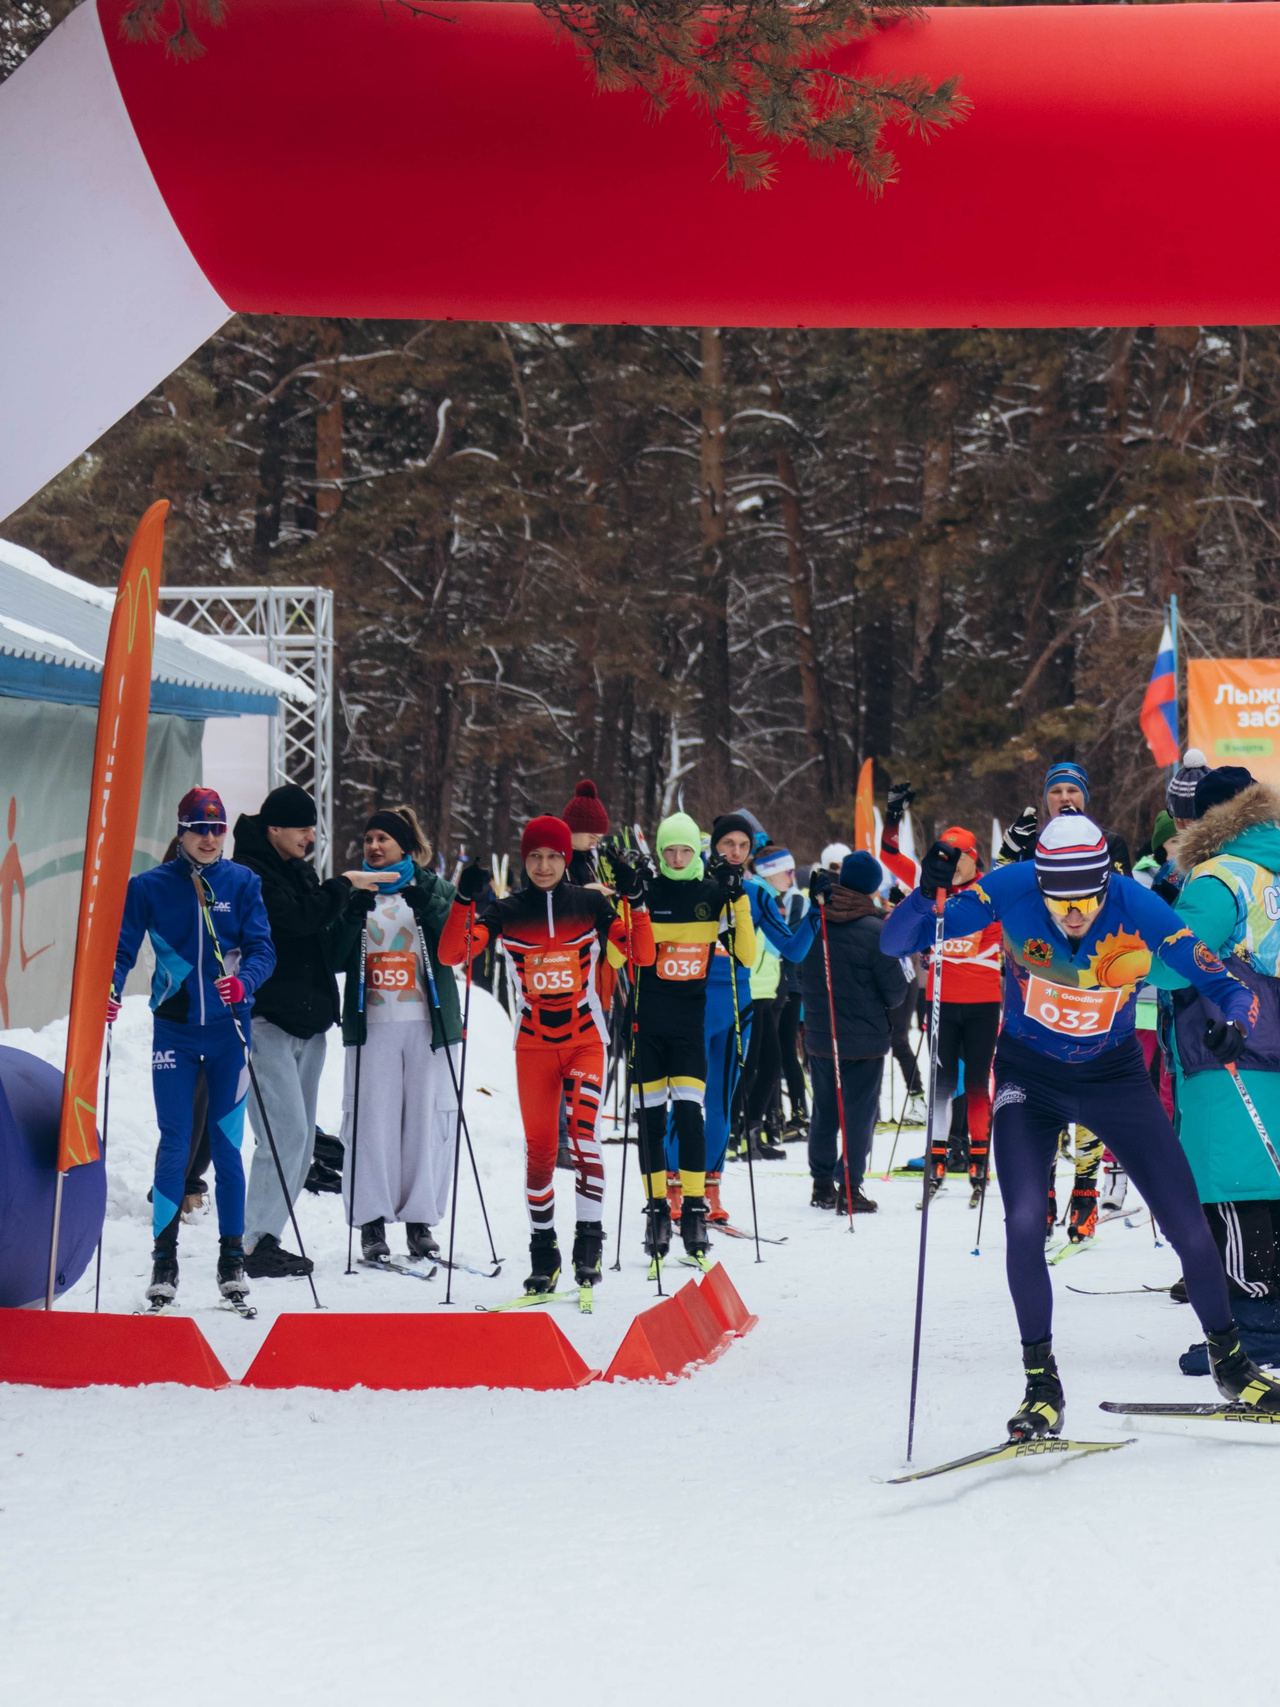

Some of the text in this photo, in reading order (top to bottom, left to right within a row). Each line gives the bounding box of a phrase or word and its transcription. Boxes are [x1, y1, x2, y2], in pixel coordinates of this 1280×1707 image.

[943, 940, 973, 953] 037
[543, 955, 570, 964] Goodline
[664, 960, 701, 976] 036
[372, 969, 409, 986] 059
[533, 970, 574, 990] 035
[1061, 992, 1104, 1004] Goodline
[1039, 1003, 1100, 1030] 032
[570, 1068, 600, 1082] Easy ski
[1015, 1442, 1069, 1458] FISCHER
